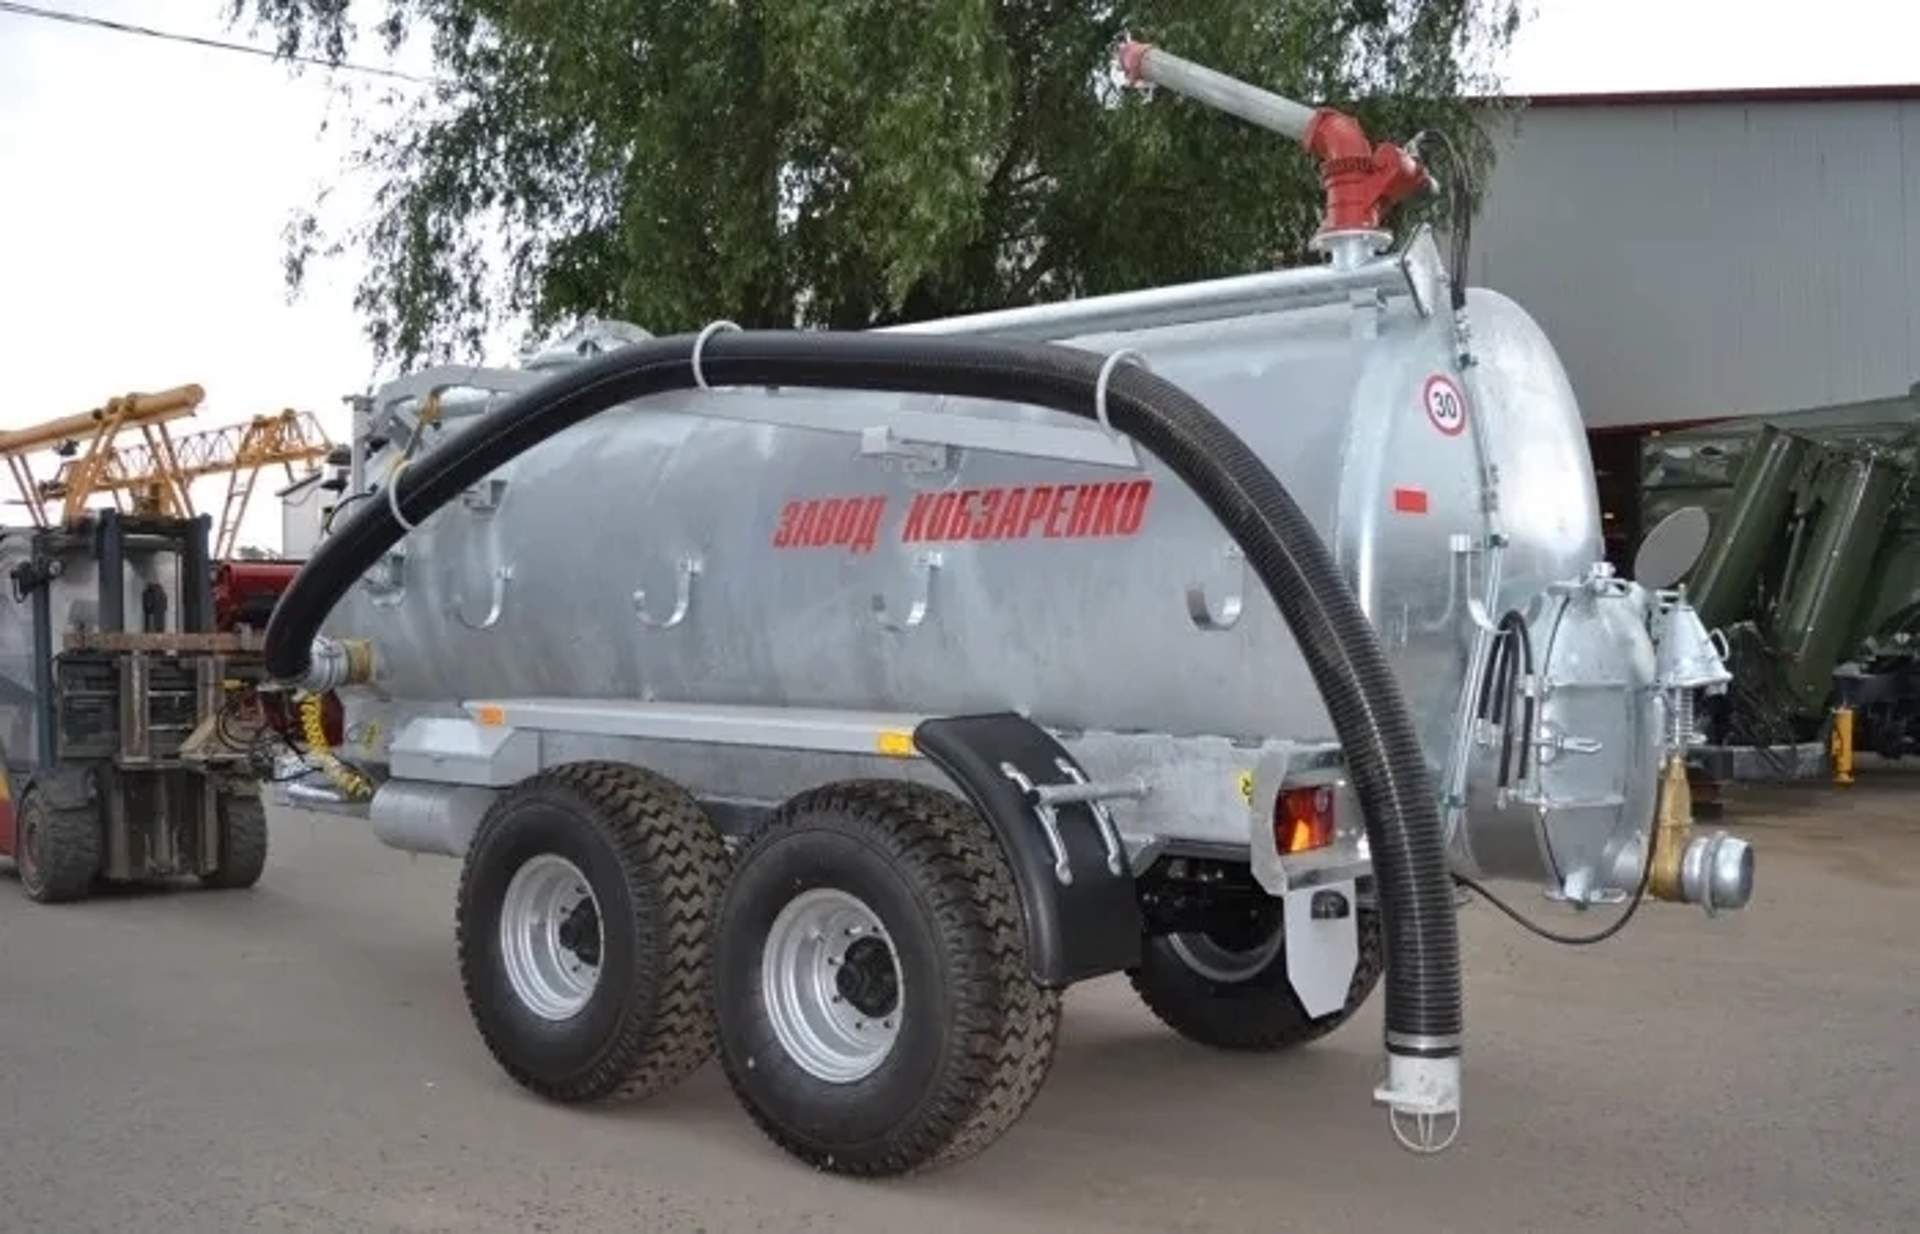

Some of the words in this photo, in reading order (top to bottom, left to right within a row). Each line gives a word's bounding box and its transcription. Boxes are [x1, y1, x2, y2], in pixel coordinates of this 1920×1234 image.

[1433, 391, 1457, 419] 30
[773, 496, 885, 553] ЗАВОД
[902, 479, 1152, 543] КОБЗАРЕНКО
